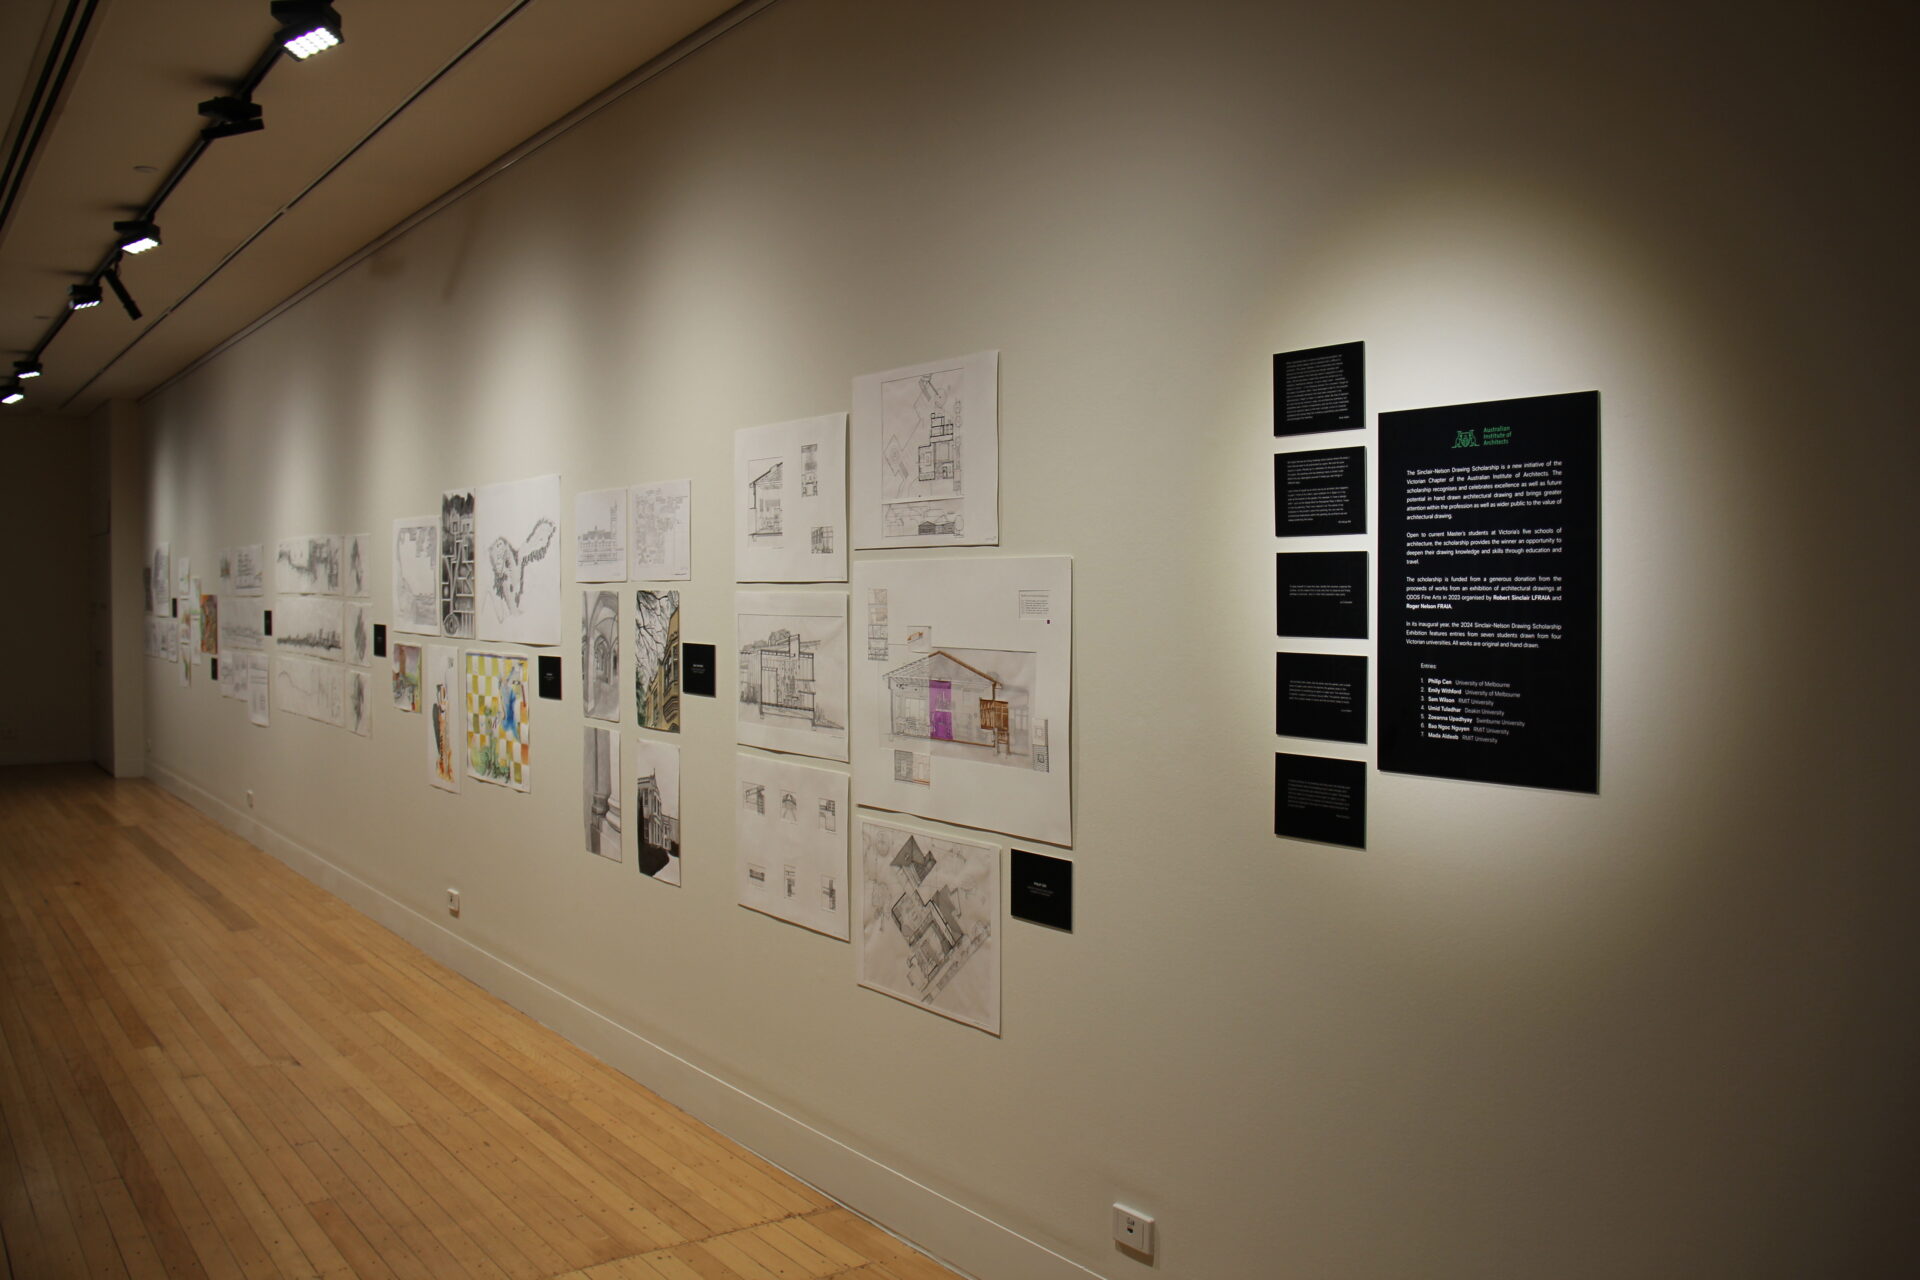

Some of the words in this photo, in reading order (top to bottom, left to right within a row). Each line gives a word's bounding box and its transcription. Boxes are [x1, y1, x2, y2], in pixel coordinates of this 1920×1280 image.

[1484, 425, 1510, 433] Australian
[1484, 438, 1508, 446] Architects
[1452, 466, 1470, 474] Drawing
[1472, 464, 1499, 472] Scholarship
[1526, 490, 1542, 498] brings
[1449, 502, 1473, 510] profession
